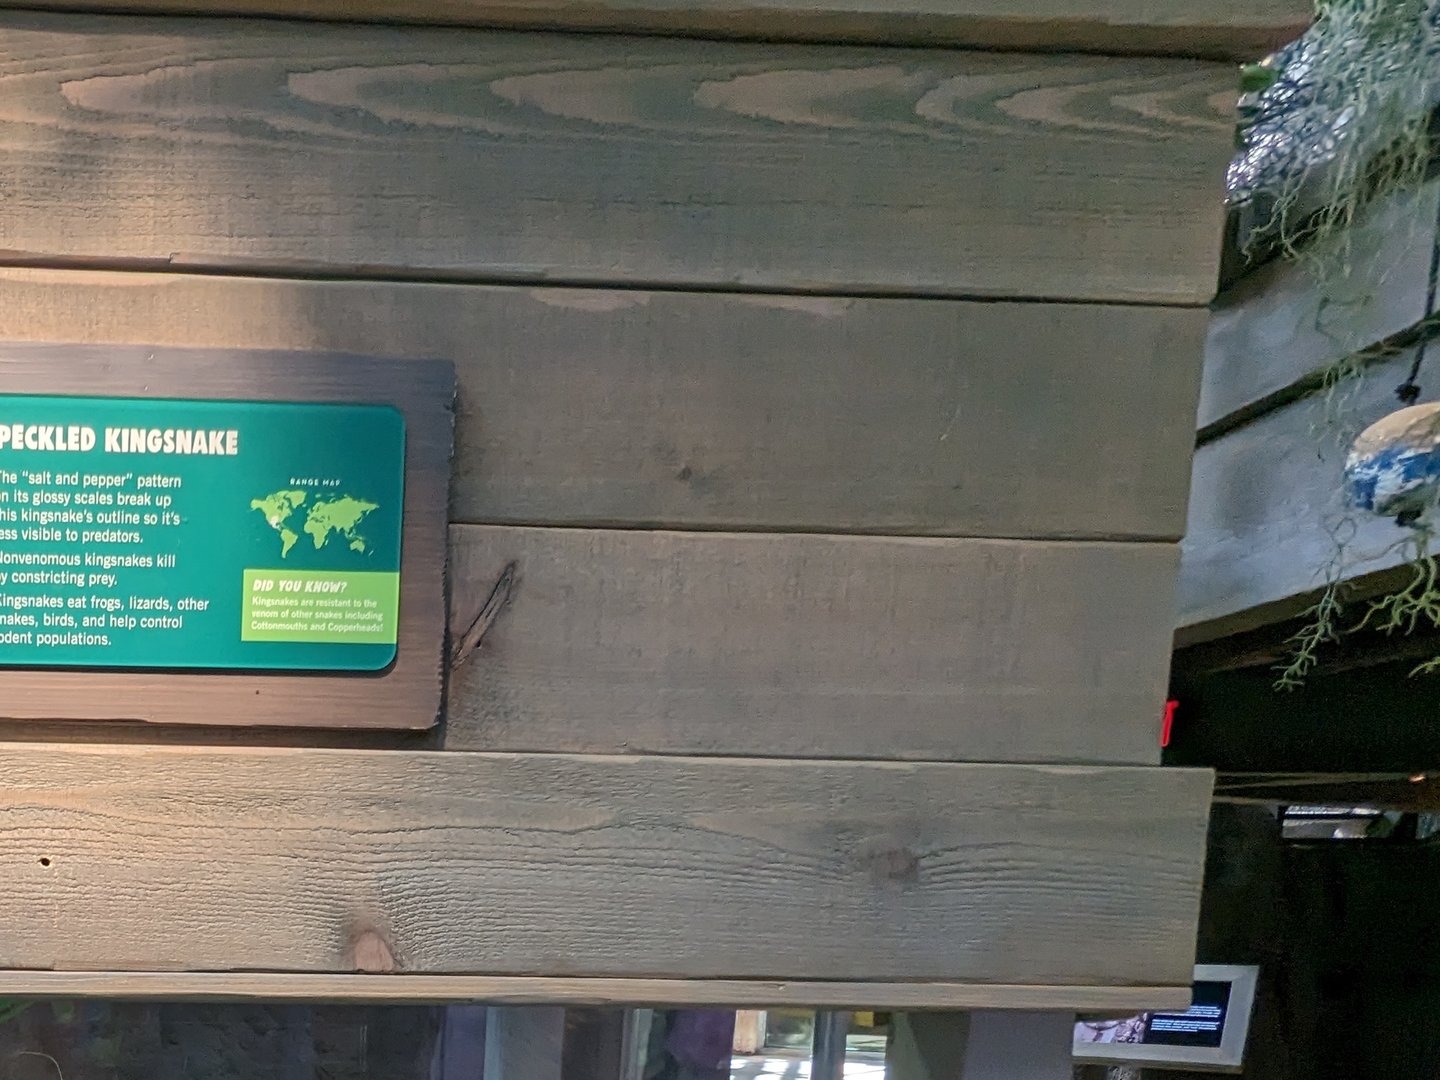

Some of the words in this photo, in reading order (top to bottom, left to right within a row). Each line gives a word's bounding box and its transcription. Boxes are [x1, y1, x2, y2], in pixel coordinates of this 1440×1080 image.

[105, 428, 238, 455] KINGSNAKE
[56, 472, 78, 485] and
[137, 475, 181, 488] pattern
[290, 478, 319, 486] RANGE
[14, 490, 29, 503] its
[33, 491, 69, 507] glossy
[75, 493, 113, 505] scales
[117, 493, 151, 506] break
[156, 496, 171, 508] up
[97, 511, 139, 524] outline
[144, 515, 157, 525] so
[22, 528, 61, 541] visible
[66, 530, 78, 542] to
[83, 528, 143, 544] predators.
[85, 553, 152, 568] kingsnakes
[157, 554, 175, 567] kill
[12, 571, 85, 586] constricting
[89, 574, 117, 587] prey.
[253, 580, 273, 592] DID
[280, 580, 302, 592] YOU
[304, 581, 348, 592] KNOW?
[67, 596, 86, 608] eat
[91, 595, 124, 611] frogs,
[129, 596, 173, 612] lizards,
[177, 598, 209, 610] other
[252, 596, 298, 607] Kingsnakes
[300, 598, 313, 606] are
[316, 598, 350, 607] resistant
[354, 599, 362, 607] to
[364, 599, 377, 608] the
[43, 613, 78, 628] birds,
[83, 615, 105, 627] and
[110, 615, 136, 629] help
[140, 616, 183, 628] control
[252, 610, 278, 618] venom
[281, 609, 289, 618] of
[291, 610, 312, 618] other
[315, 610, 342, 619] snakes
[345, 611, 383, 622] including
[251, 621, 308, 630] Cottonmouths
[310, 623, 326, 631] and
[37, 632, 111, 647] populations.
